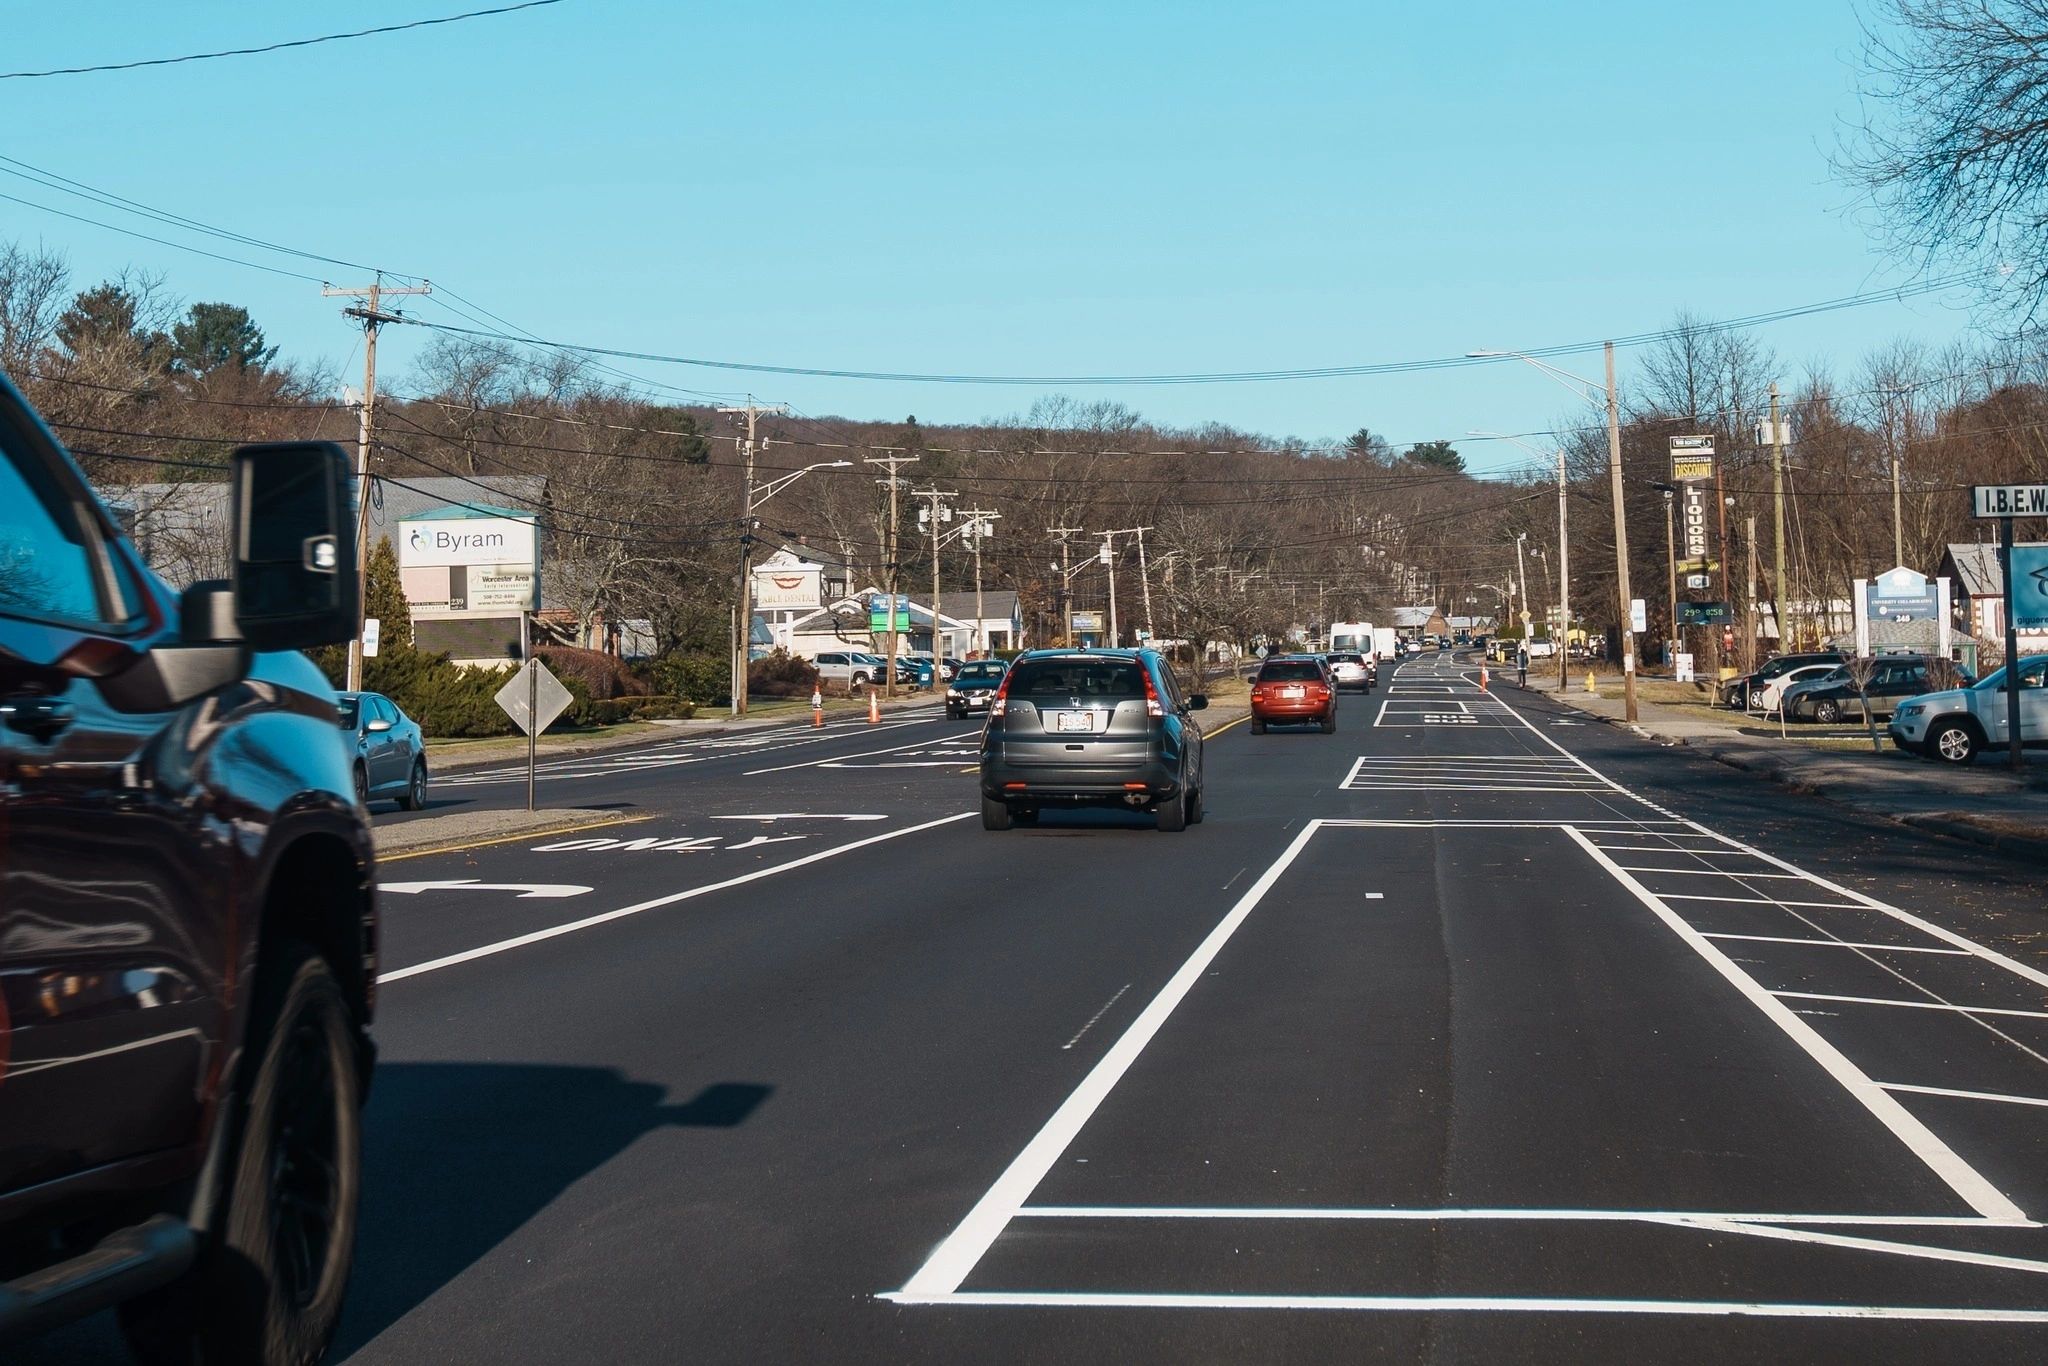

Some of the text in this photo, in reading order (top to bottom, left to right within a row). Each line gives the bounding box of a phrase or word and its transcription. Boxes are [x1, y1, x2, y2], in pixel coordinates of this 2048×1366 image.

[1675, 463, 1712, 479] DISCOUNT
[1687, 485, 1705, 555] LIQUORS
[436, 531, 504, 553] Byram
[482, 574, 530, 583] Worcester Area
[1690, 577, 1708, 587] ICE
[1895, 614, 1911, 622] 248
[1424, 714, 1479, 724] BUS
[530, 836, 807, 851] ONLY
